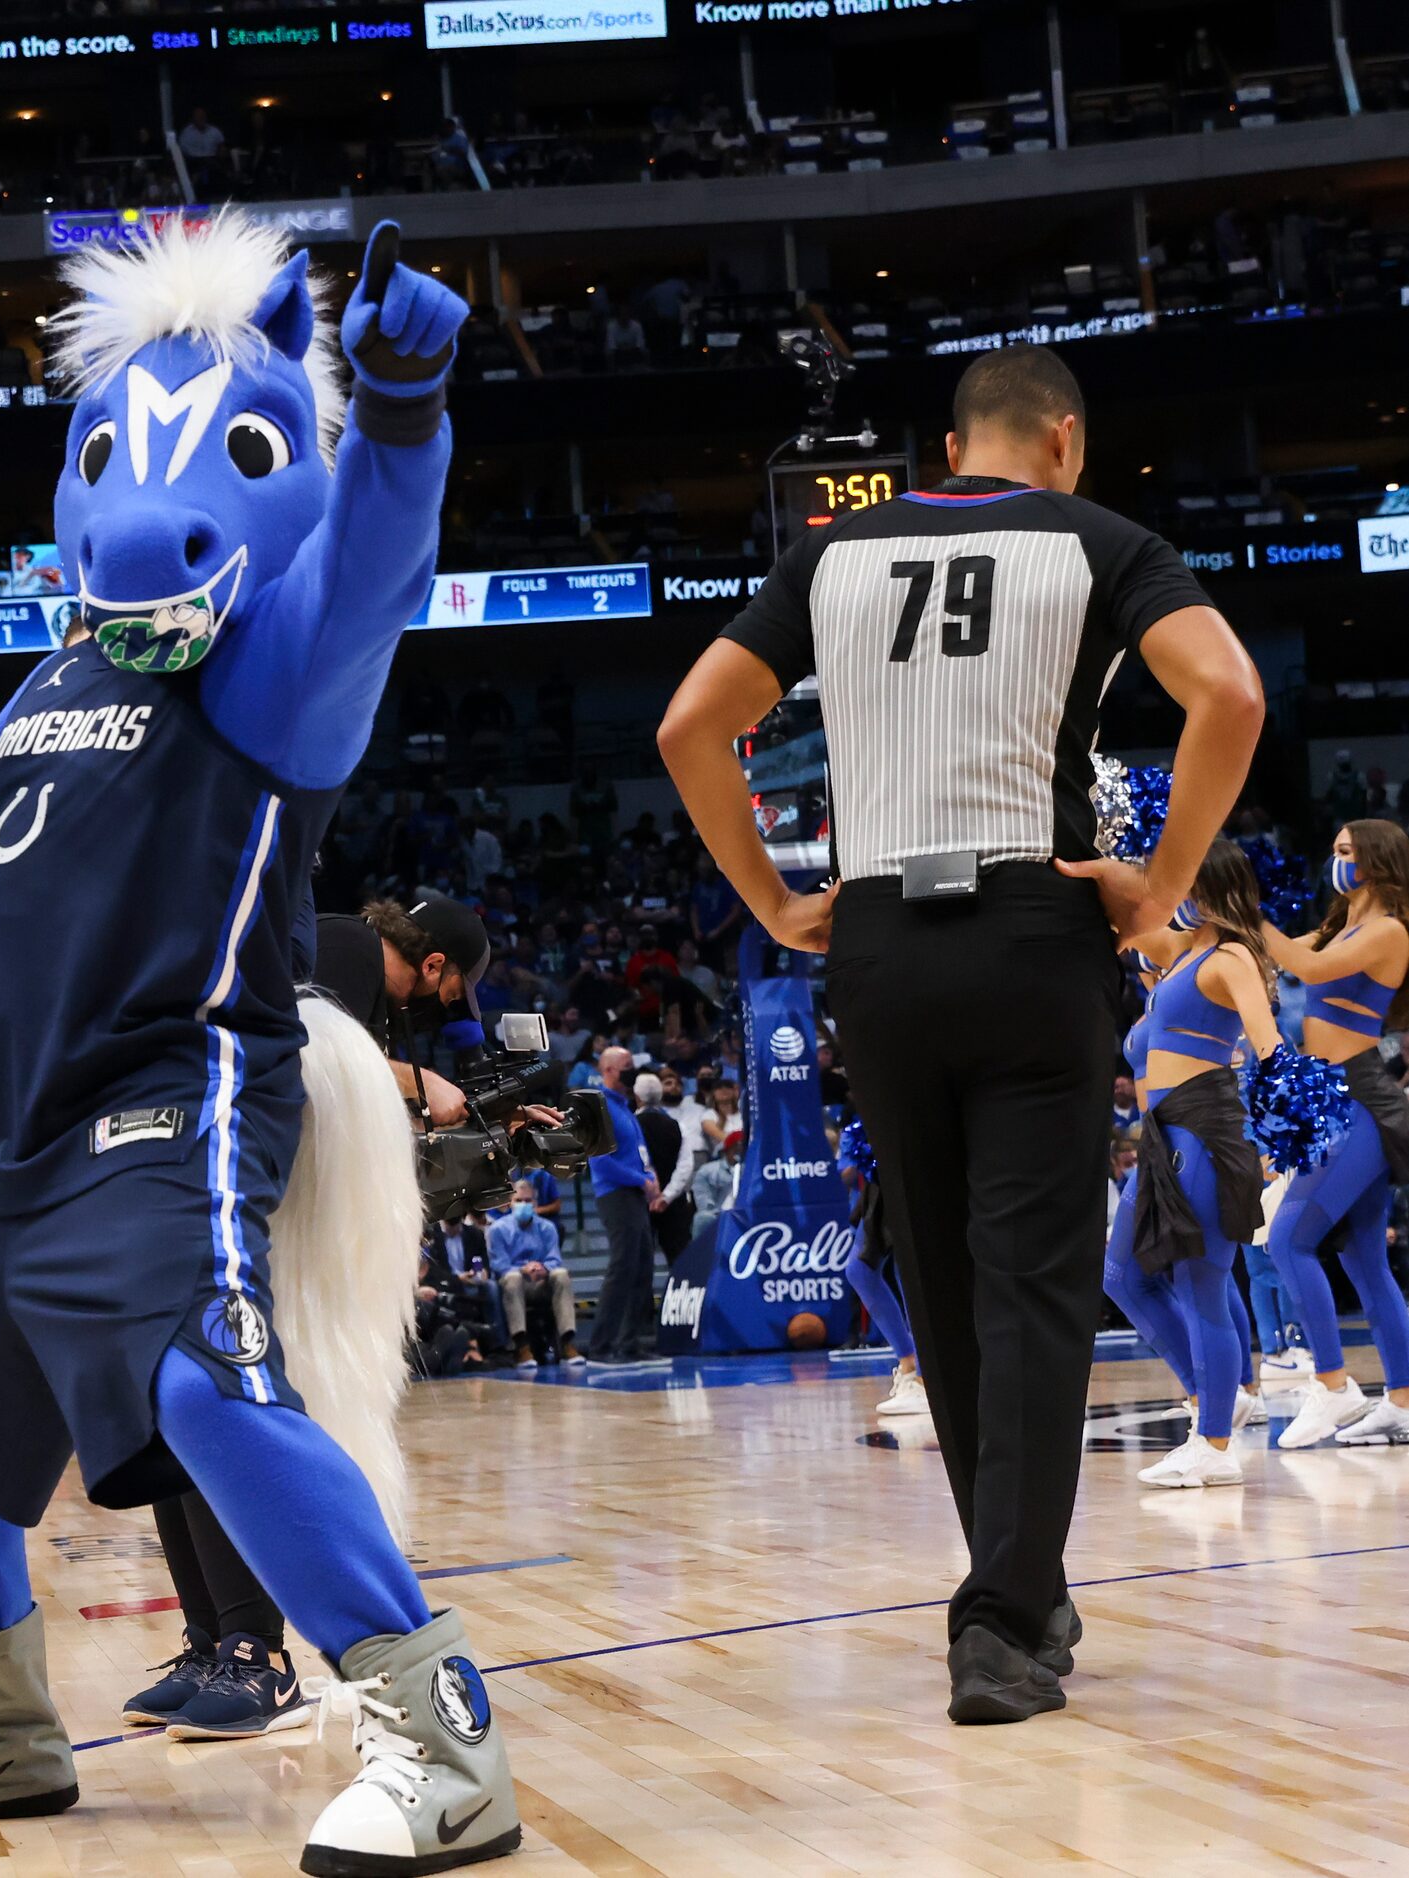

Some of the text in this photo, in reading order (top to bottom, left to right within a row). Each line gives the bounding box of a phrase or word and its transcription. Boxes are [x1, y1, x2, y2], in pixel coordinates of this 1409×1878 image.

[696, 1, 762, 23] Know
[768, 0, 829, 19] more
[20, 36, 61, 57] the
[65, 35, 135, 55] score.
[152, 31, 200, 49] Stats
[228, 26, 320, 46] Standings
[347, 21, 412, 40] Stories
[816, 473, 892, 510] 7:50
[1266, 541, 1343, 564] Stories
[503, 573, 636, 592] FOULS TIMEOUTS
[664, 576, 740, 600] Know
[518, 591, 609, 616] 1 2
[889, 555, 996, 662] 79
[2, 625, 13, 646] 1
[770, 1064, 810, 1083] AT&T
[763, 1156, 828, 1181] chime
[729, 1220, 855, 1280] Ball
[763, 1277, 844, 1303] SPORTS
[661, 1277, 706, 1340] betway
